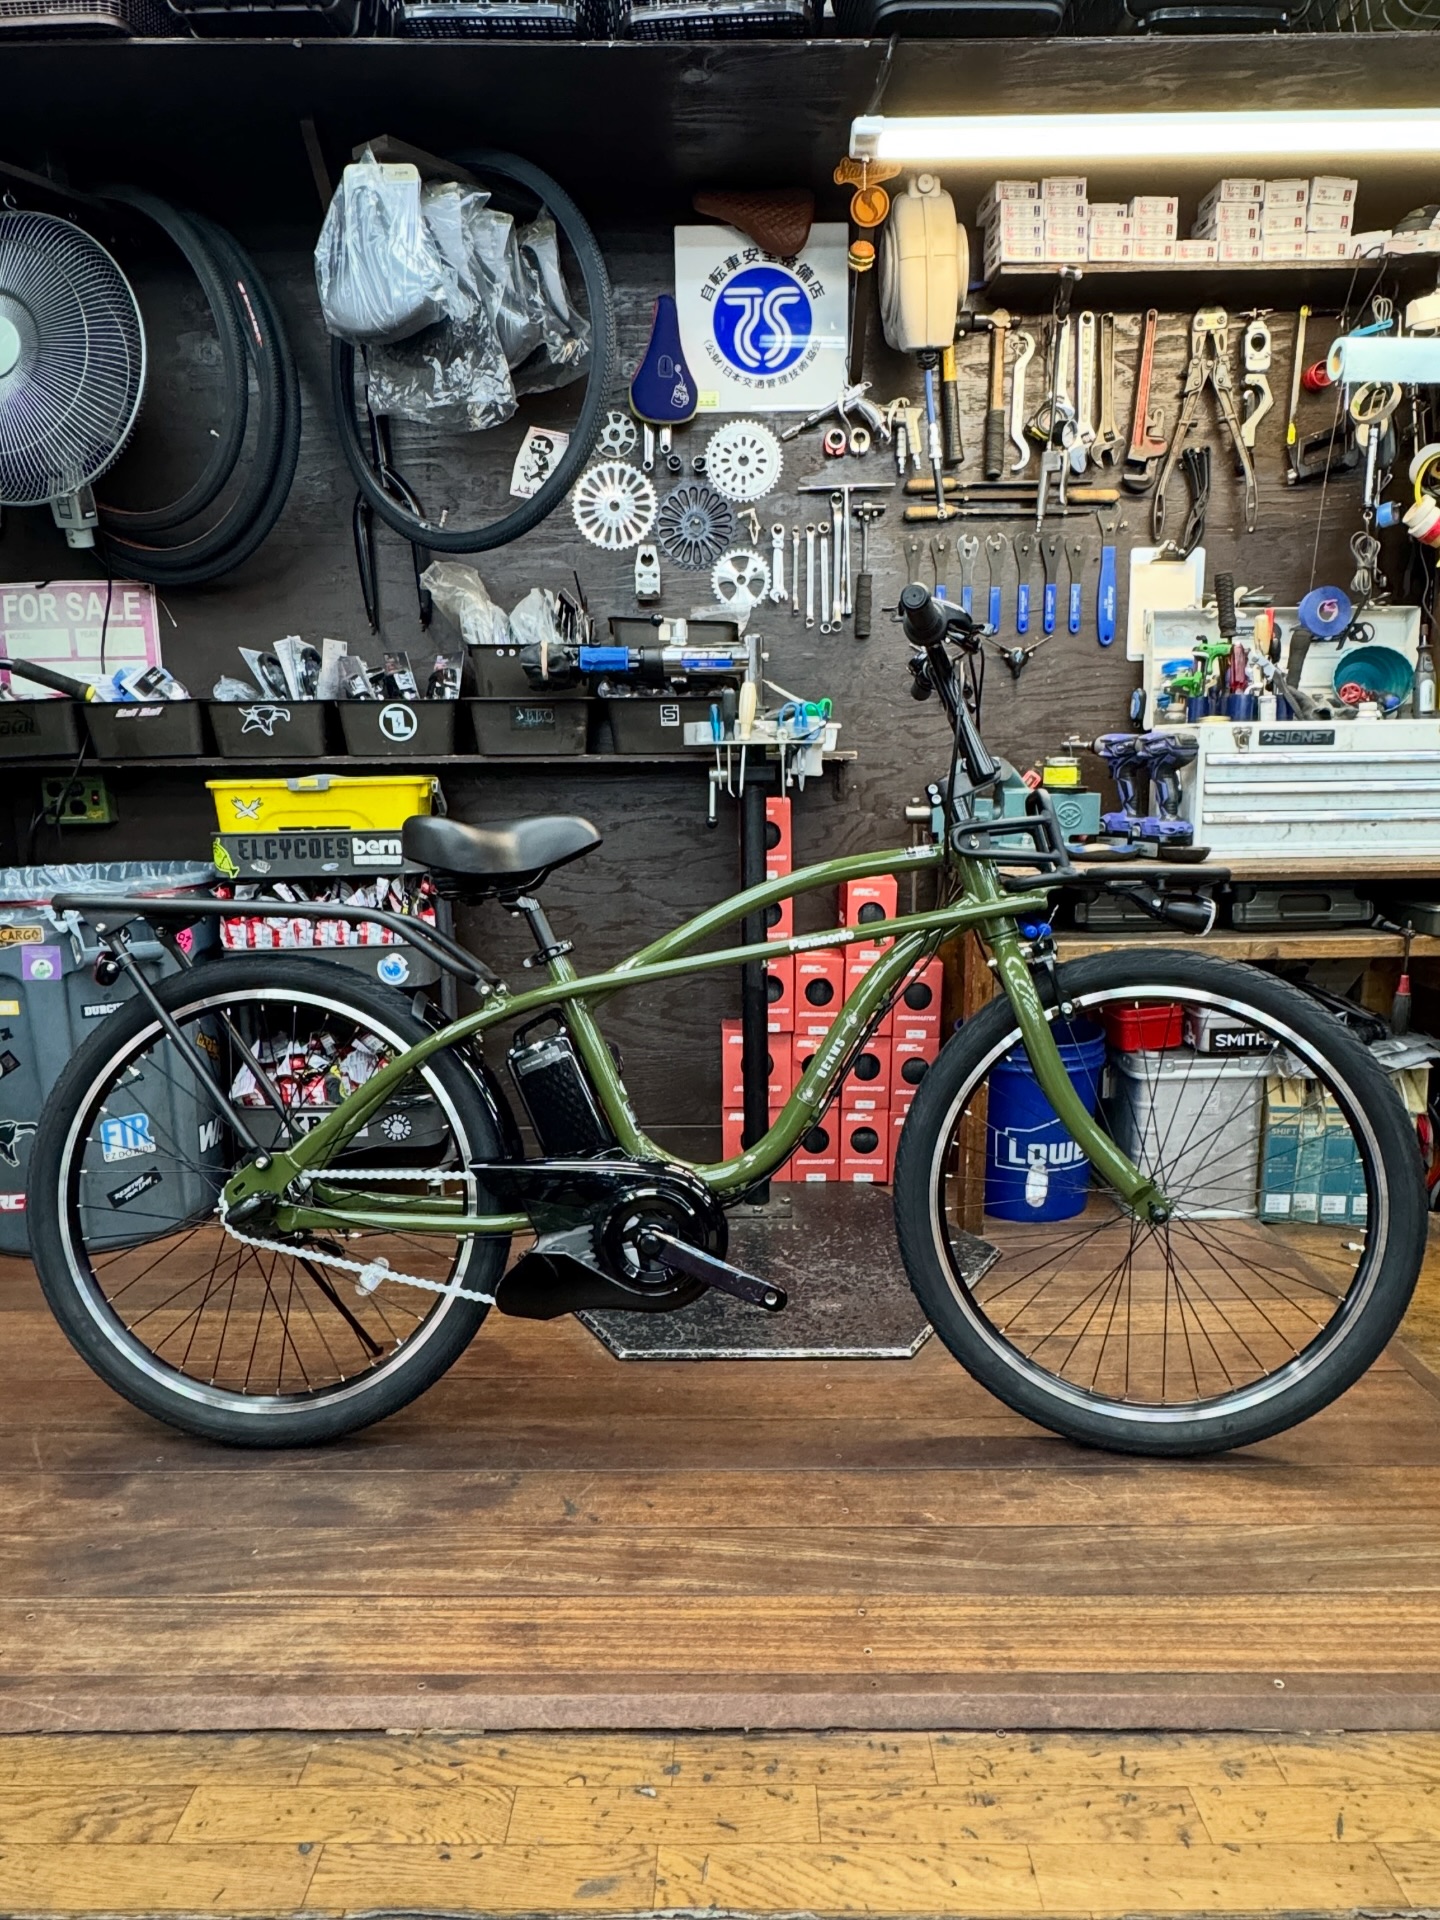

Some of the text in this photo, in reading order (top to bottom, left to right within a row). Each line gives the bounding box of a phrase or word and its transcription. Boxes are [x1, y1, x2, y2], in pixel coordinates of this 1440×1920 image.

[2, 591, 143, 624] FOR SALE
[1273, 731, 1333, 744] SIGNET
[352, 837, 403, 855] bern
[0, 930, 40, 941] CARGO
[789, 930, 855, 951] Panasonic
[84, 1002, 125, 1017] DURC
[1215, 1033, 1267, 1047] SMITH
[816, 1037, 846, 1079] BEAMS
[102, 1114, 152, 1153] FTR
[1271, 1127, 1298, 1136] SHIFT
